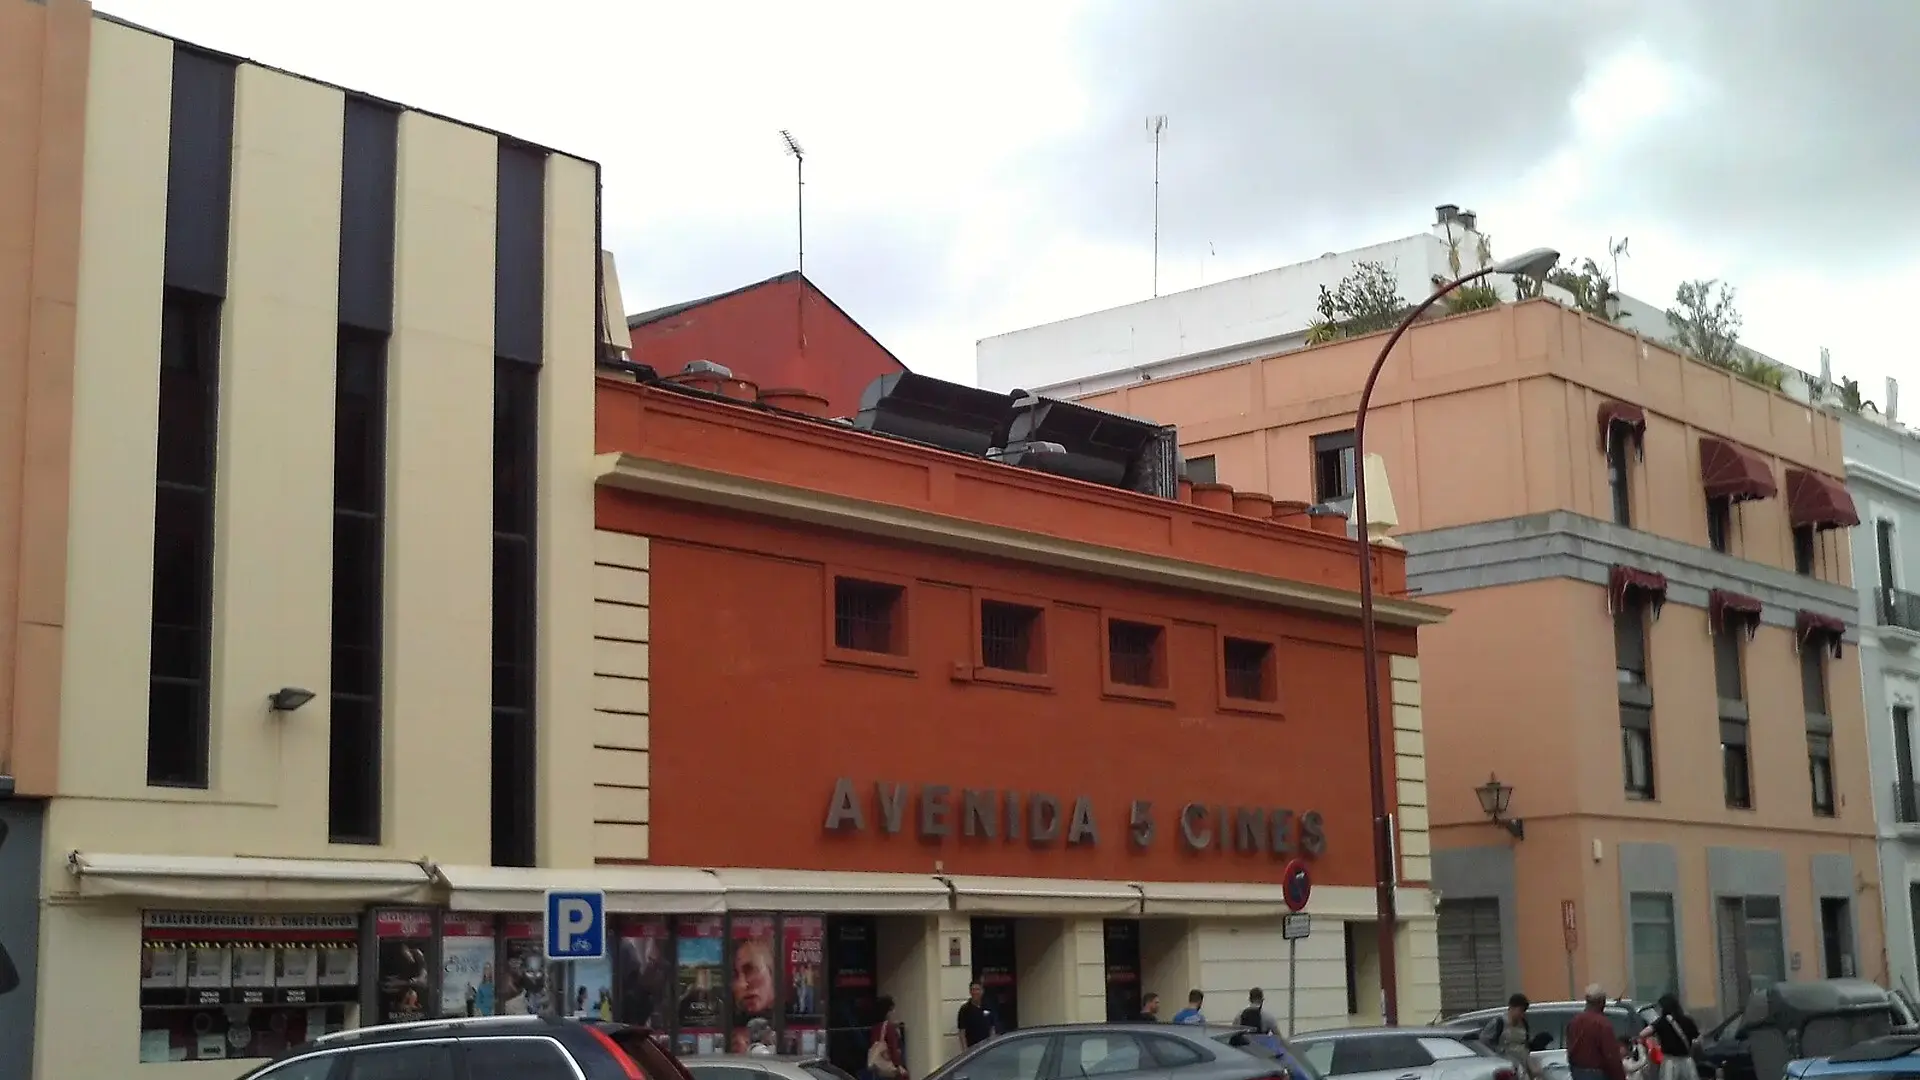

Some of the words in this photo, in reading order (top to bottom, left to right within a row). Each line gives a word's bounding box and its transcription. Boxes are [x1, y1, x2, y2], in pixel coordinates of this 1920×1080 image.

[824, 777, 1099, 844] AVENIDA
[1130, 800, 1155, 848] 5
[1181, 803, 1327, 857] CINES
[159, 914, 192, 925] SALAS
[193, 914, 254, 926] ESPECIALES
[558, 899, 594, 952] P
